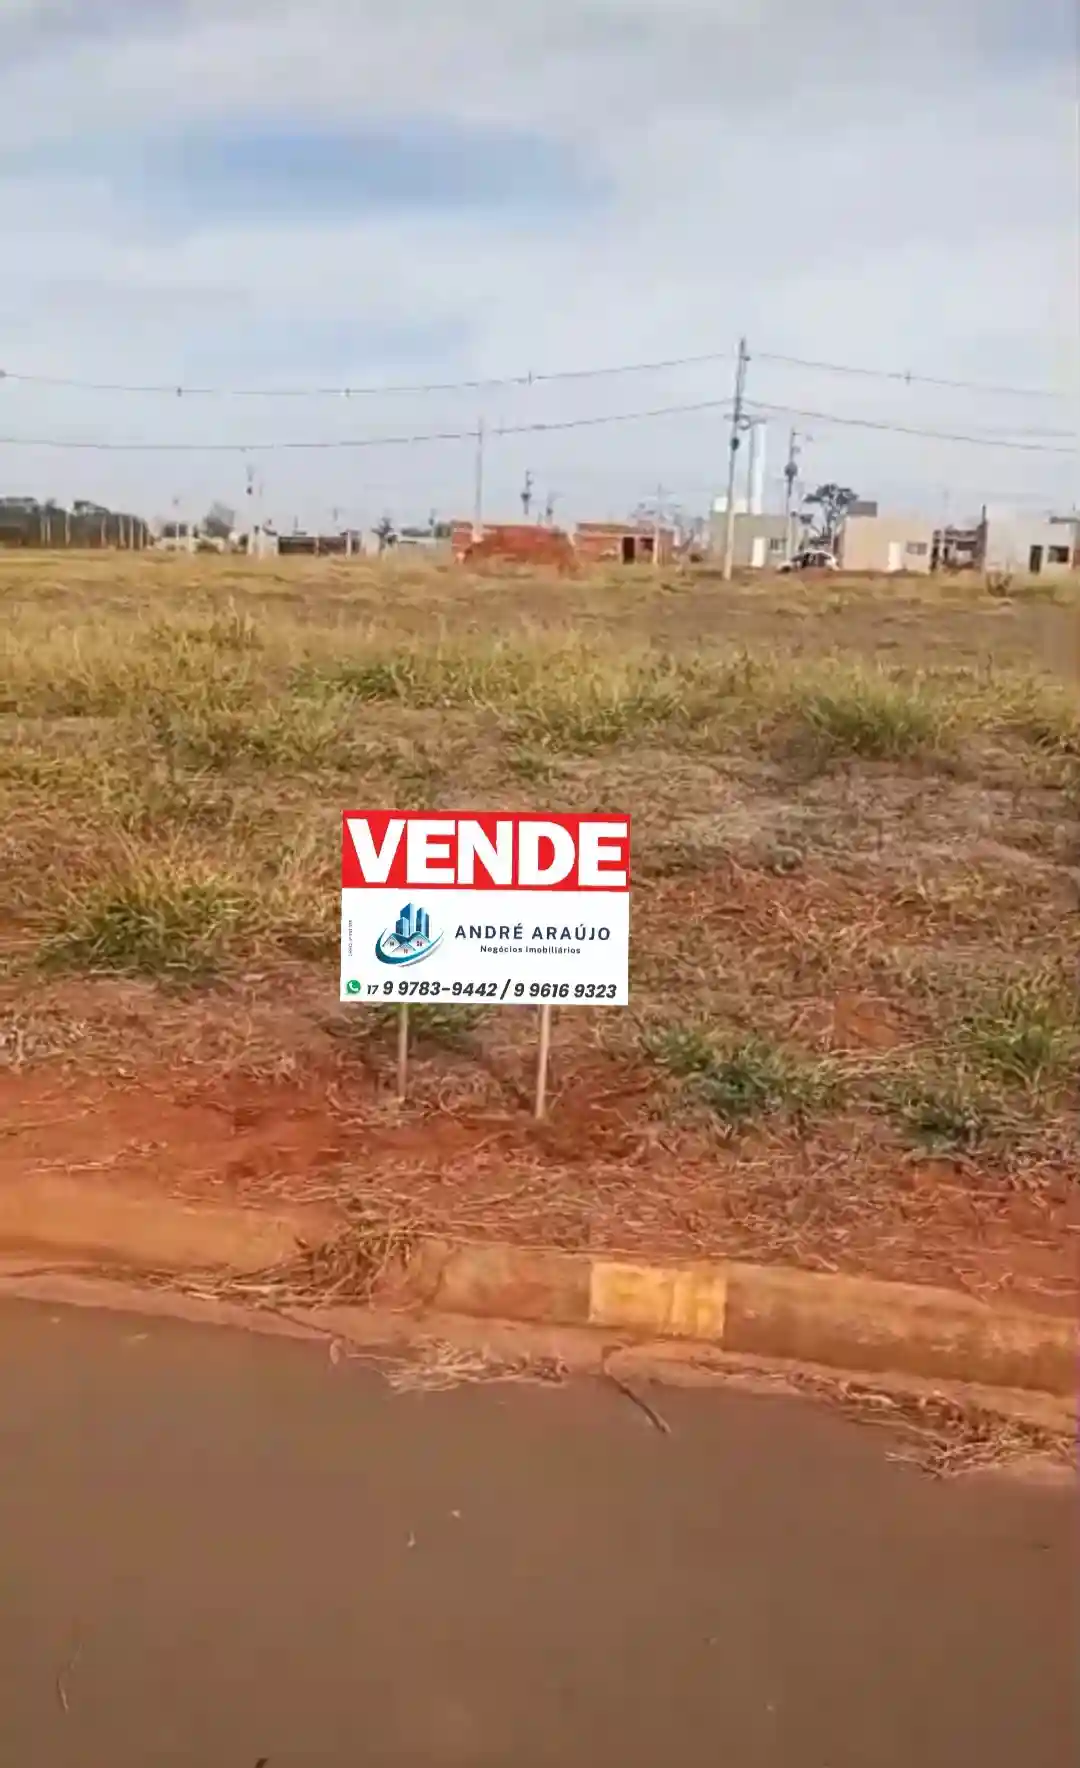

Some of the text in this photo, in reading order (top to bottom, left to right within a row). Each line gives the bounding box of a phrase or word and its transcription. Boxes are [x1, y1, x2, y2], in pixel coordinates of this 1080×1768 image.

[346, 818, 628, 887] VENDE
[455, 921, 611, 941] ANDRÉ ARAÚJO
[480, 944, 523, 955] Negócios
[367, 979, 617, 1000] 17 9 9783-9442 / 9 9616 9323
